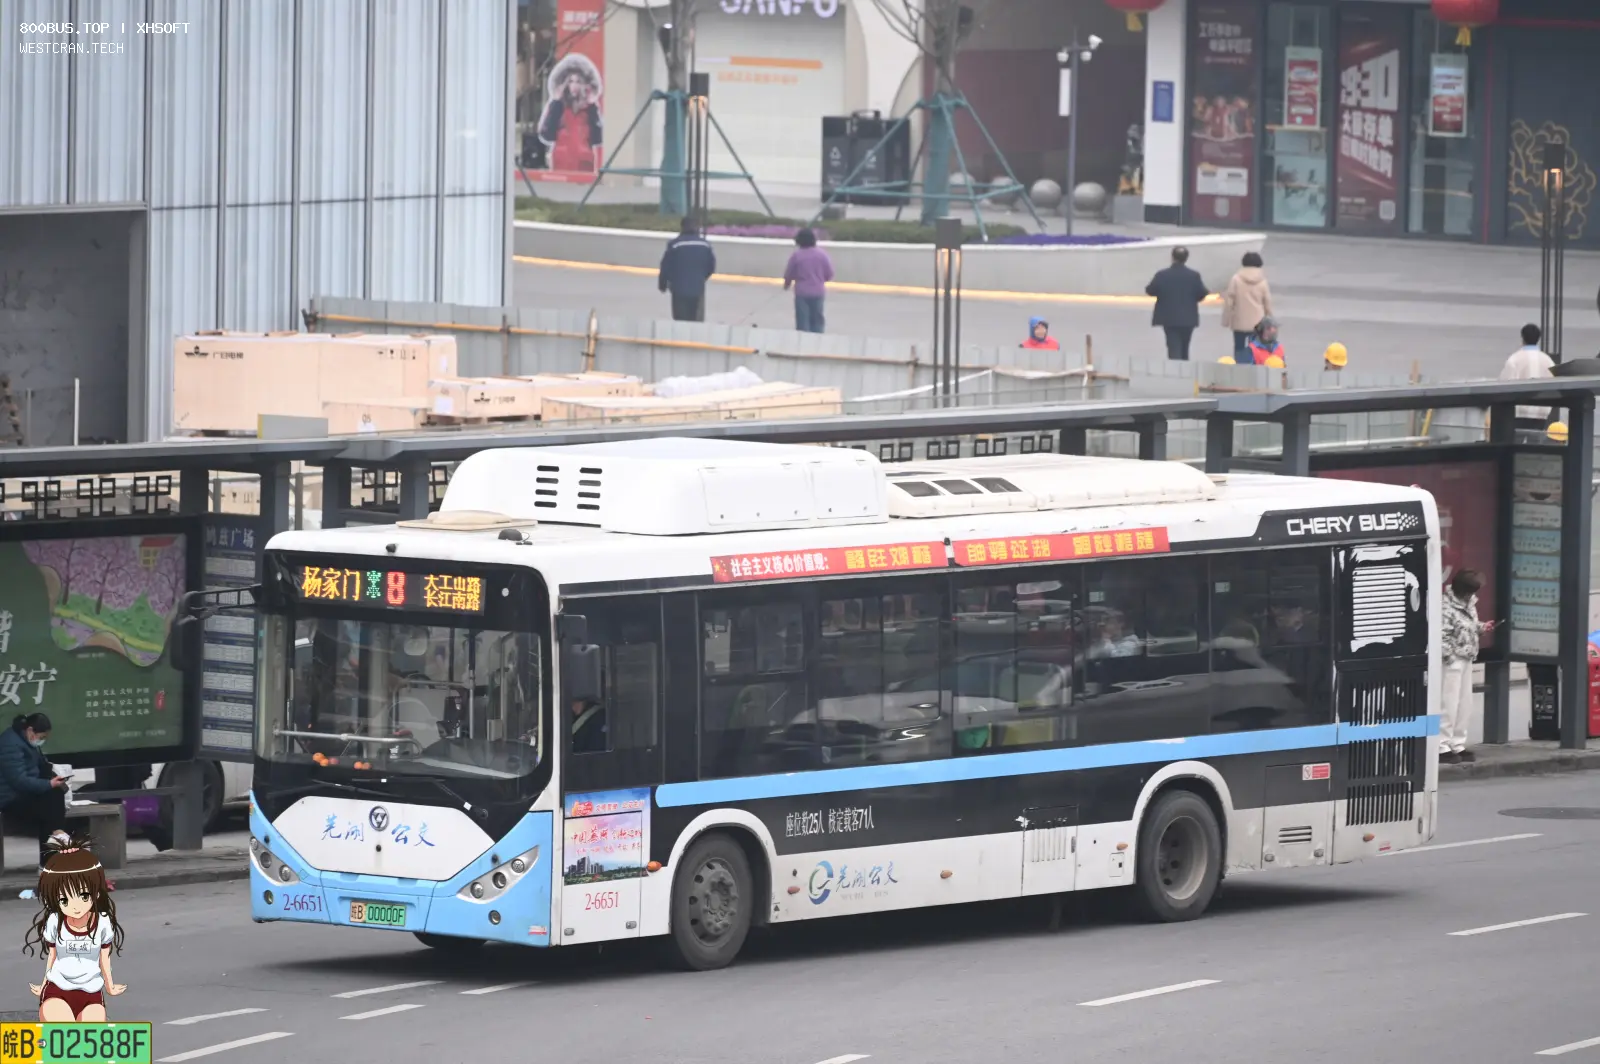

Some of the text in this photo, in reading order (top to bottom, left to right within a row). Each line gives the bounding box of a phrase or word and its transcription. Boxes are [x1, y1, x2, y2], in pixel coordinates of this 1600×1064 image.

[1286, 513, 1399, 536] CHERY BUS
[302, 566, 361, 601] 杨家门
[386, 571, 405, 605] 8
[423, 574, 481, 592] 大工山路
[423, 590, 481, 611] 长江南路
[0, 662, 58, 706] 安宁
[321, 812, 436, 848] 芜湖 公交
[785, 805, 875, 838] 座位数25人 核定载客71人
[283, 893, 323, 912] 2-6651
[585, 891, 619, 911] 2-6651
